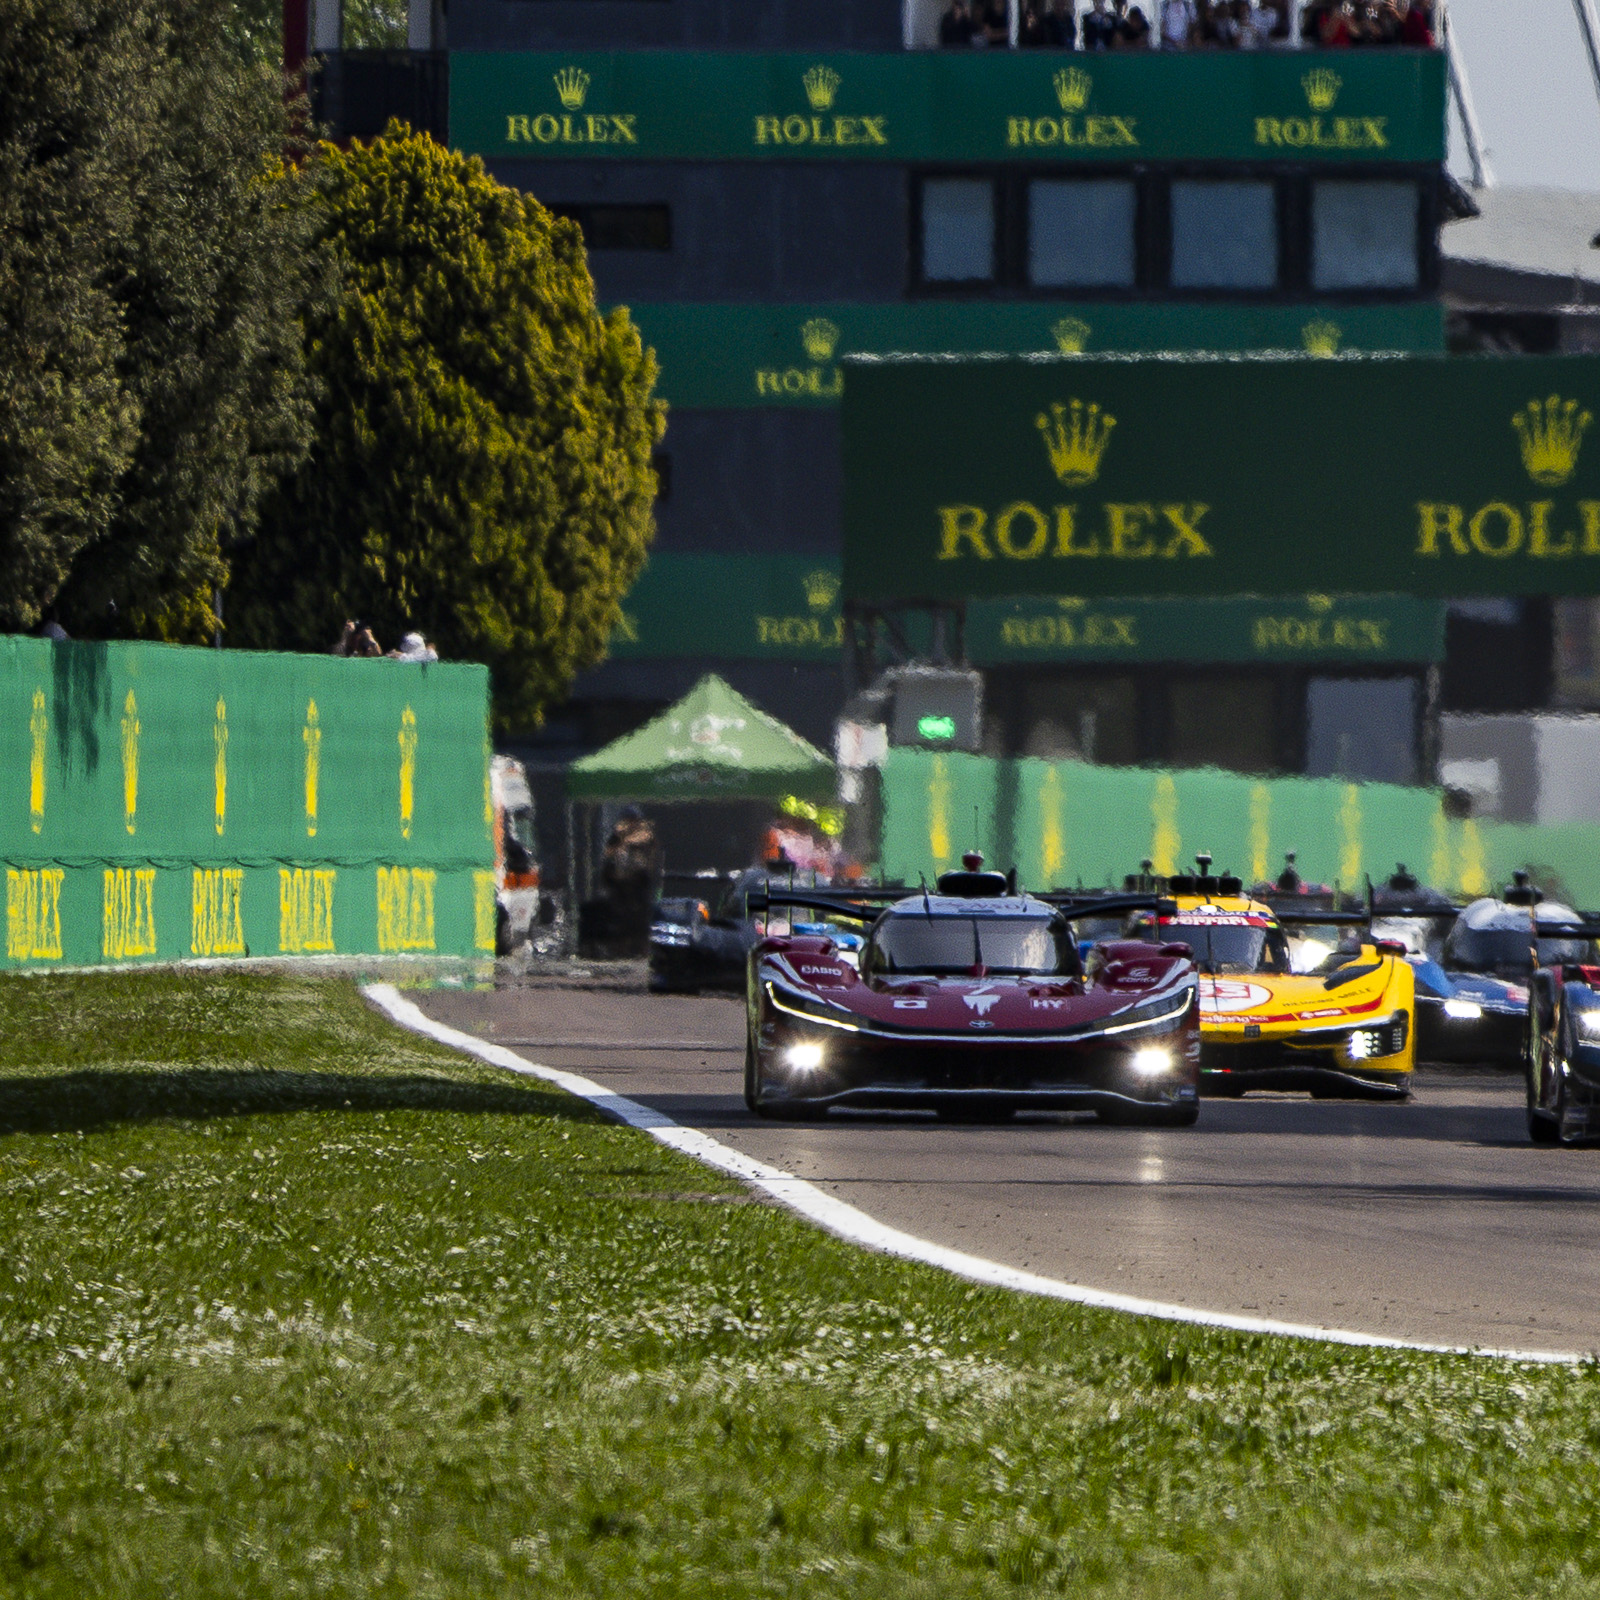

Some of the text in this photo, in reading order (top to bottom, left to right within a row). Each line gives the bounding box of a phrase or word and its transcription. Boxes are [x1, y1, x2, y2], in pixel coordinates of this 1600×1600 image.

[506, 114, 638, 144] ROLEX
[755, 115, 888, 146] ROLEX
[1007, 115, 1139, 147] ROLEX
[1255, 116, 1389, 148] ROLEX
[756, 368, 843, 396] ROL
[938, 501, 1213, 561] ROLEX
[1002, 616, 1138, 647] ROLEX
[1254, 616, 1388, 648] ROLEX
